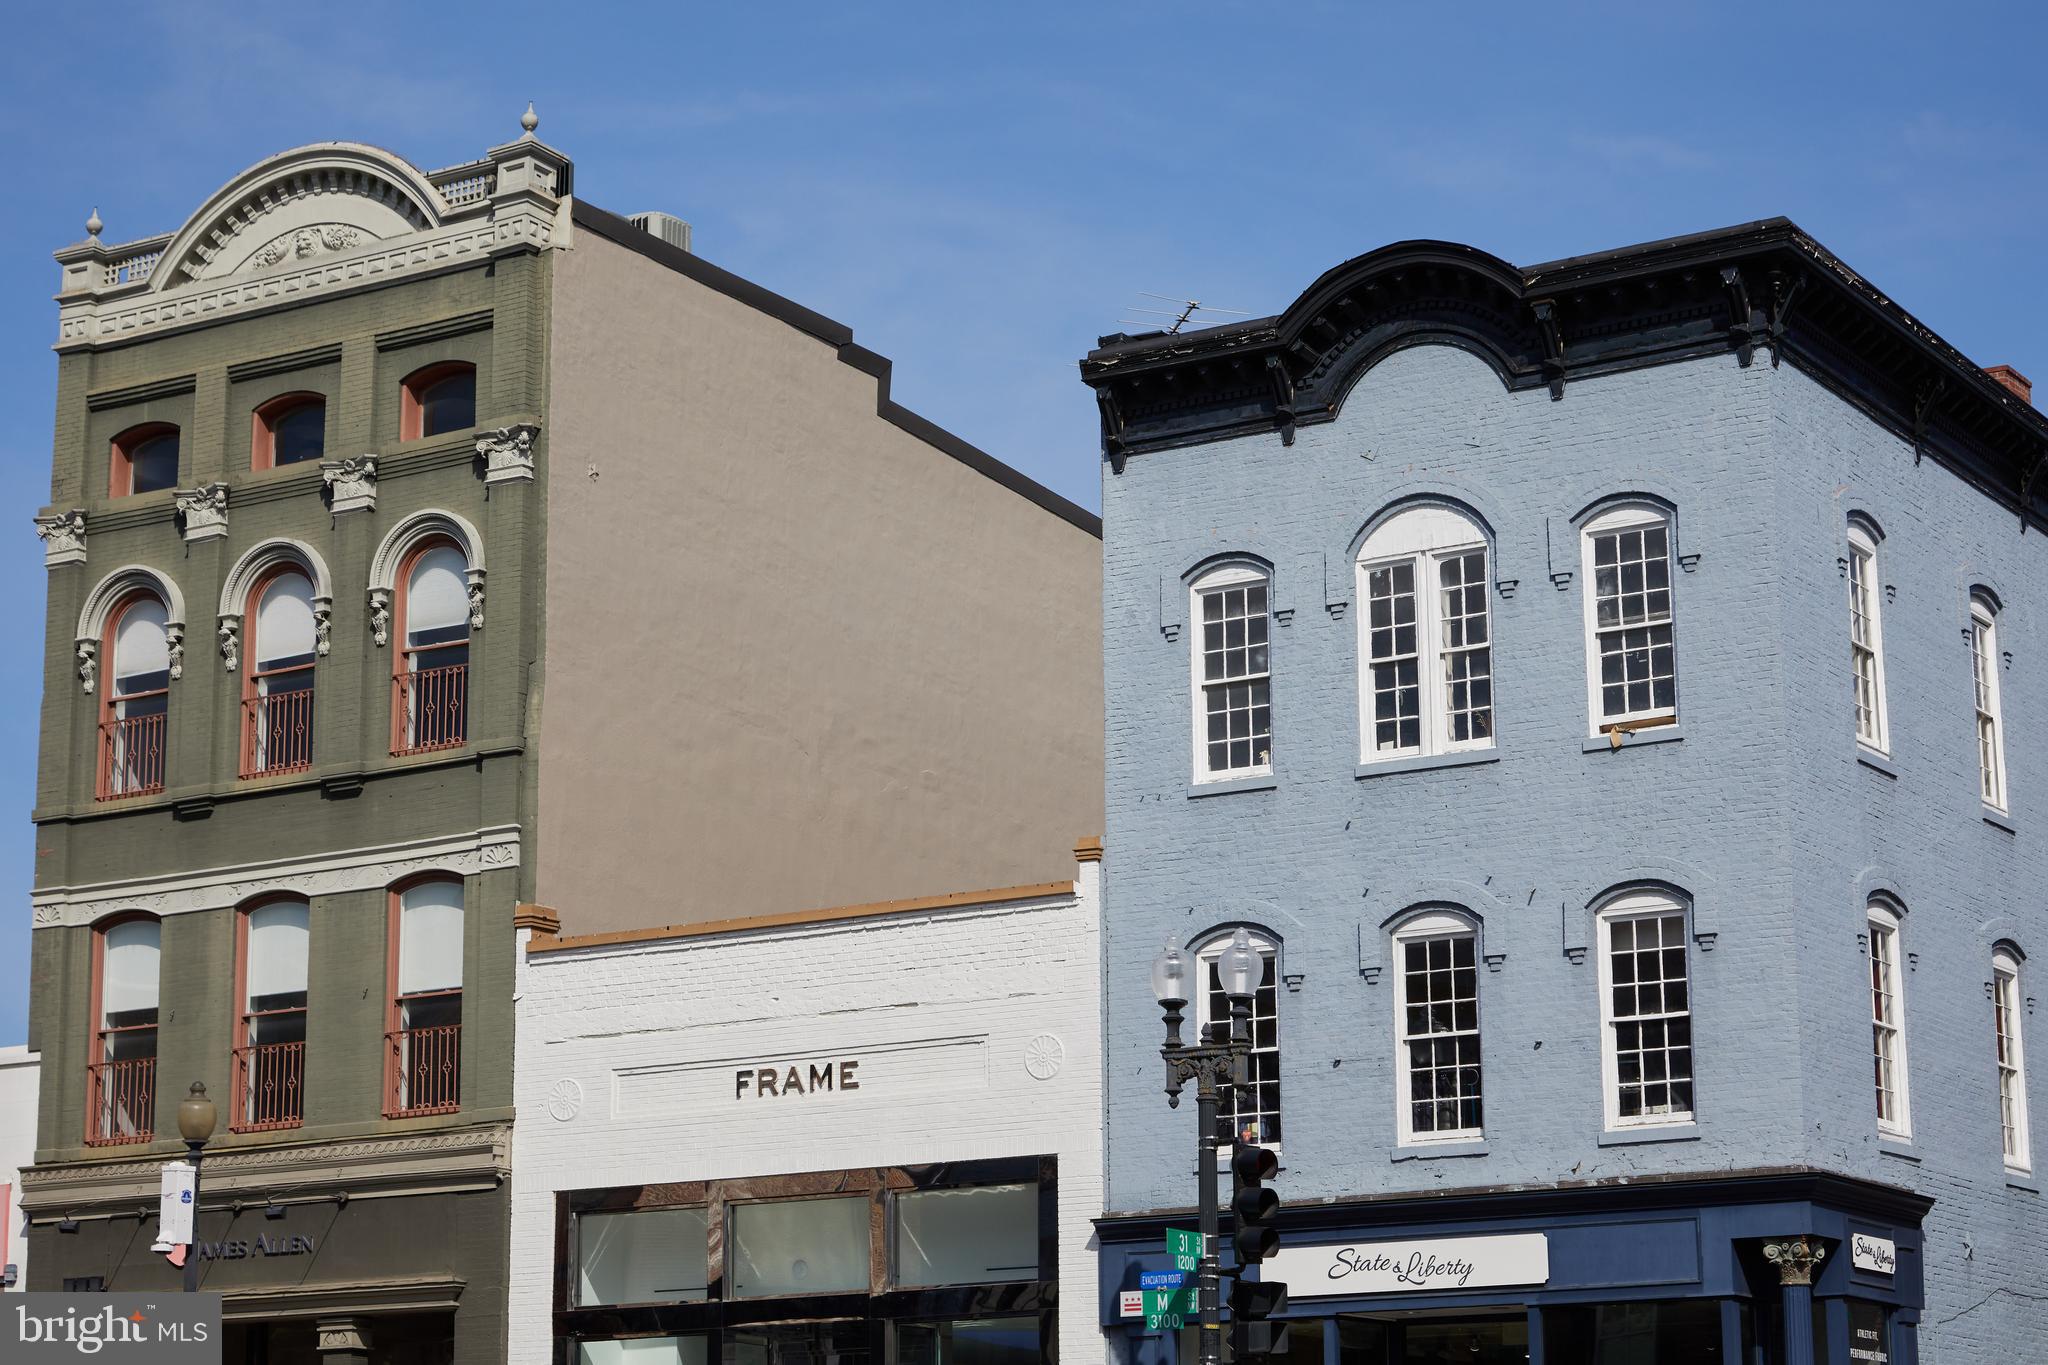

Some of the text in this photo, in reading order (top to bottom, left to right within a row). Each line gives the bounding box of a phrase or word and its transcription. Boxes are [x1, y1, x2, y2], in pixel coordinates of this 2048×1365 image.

[736, 1061, 859, 1100] FRAME
[1179, 1233, 1189, 1253] 31
[1177, 1255, 1195, 1271] 1200
[1328, 1248, 1475, 1286] State & Liberty
[1142, 1273, 1182, 1286] EVACUATION ROUTE
[1157, 1293, 1168, 1312] M
[1150, 1313, 1180, 1329] 3100
